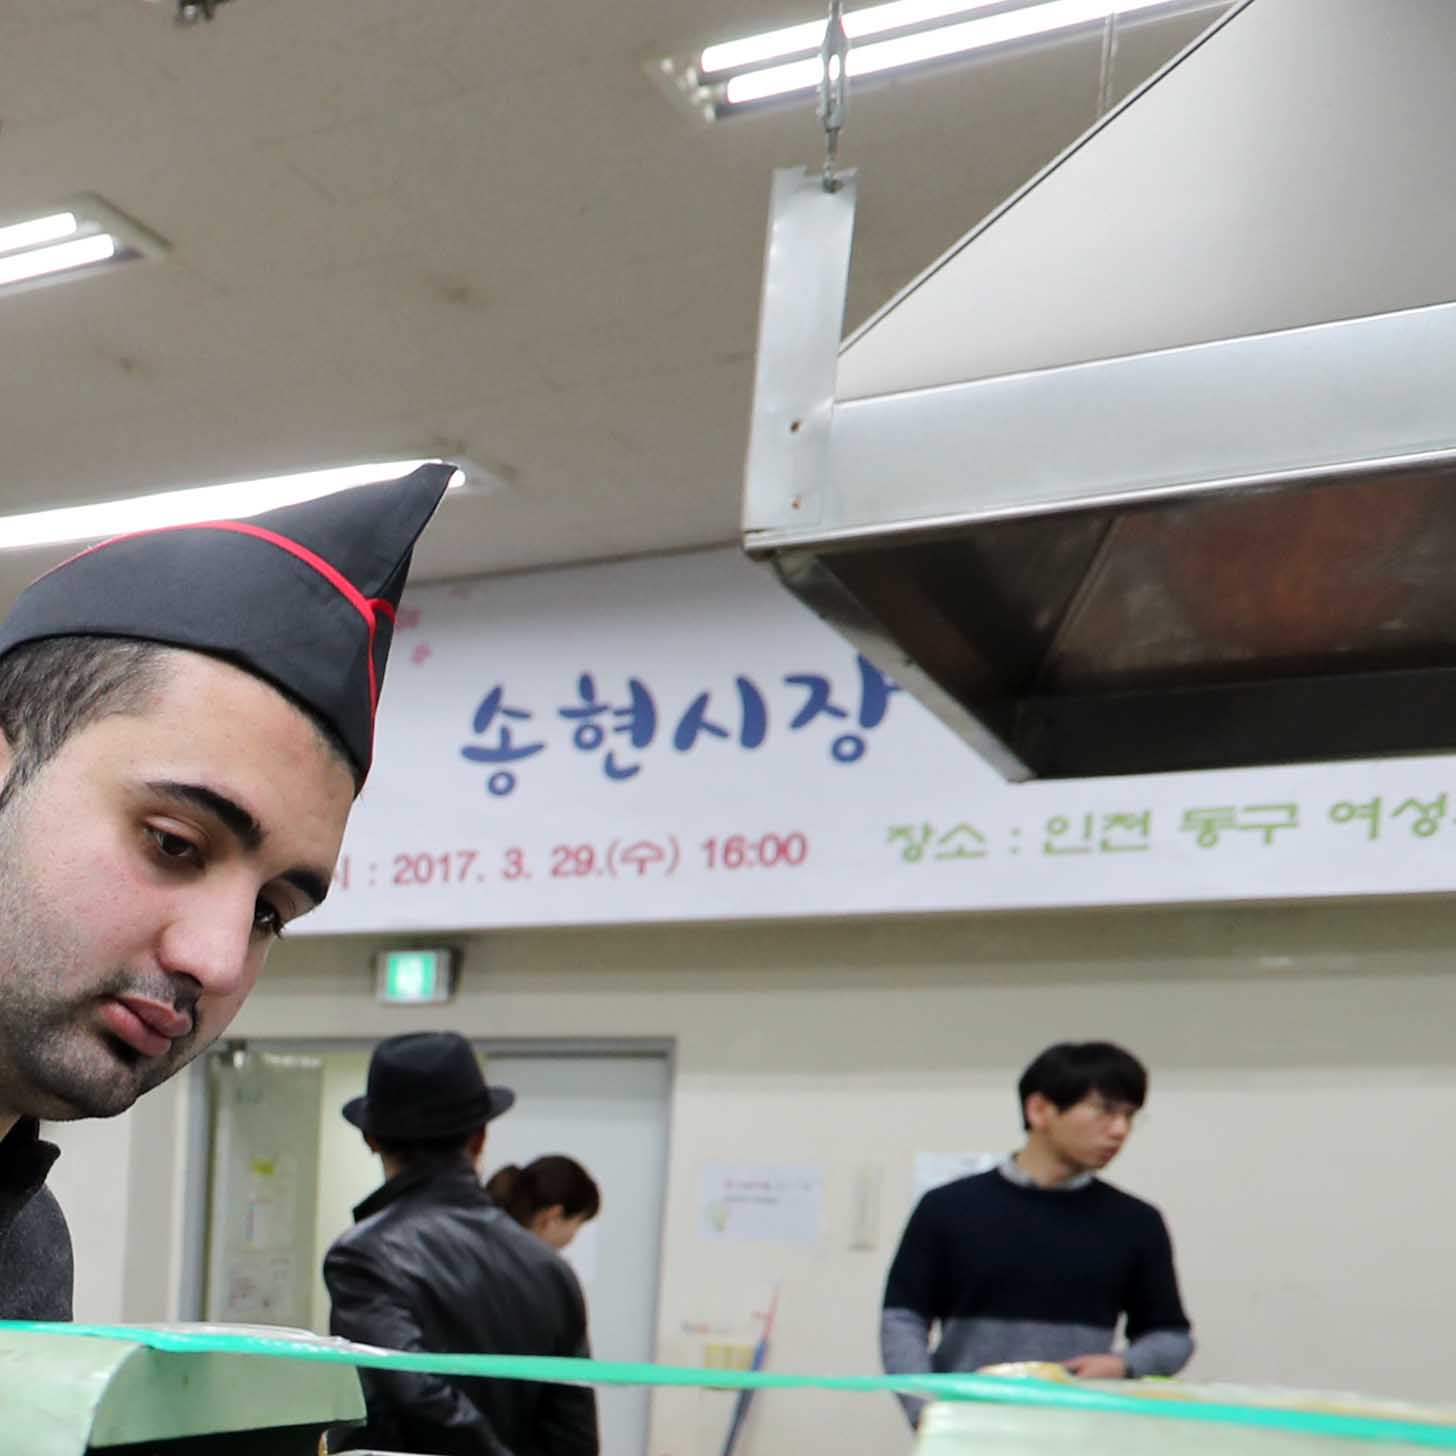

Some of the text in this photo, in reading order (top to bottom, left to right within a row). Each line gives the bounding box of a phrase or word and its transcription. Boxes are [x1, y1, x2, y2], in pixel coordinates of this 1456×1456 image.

[460, 653, 900, 797] 송현시장
[392, 849, 485, 886] 2017.
[502, 847, 532, 881] 3.
[702, 831, 809, 871] 16:00
[886, 821, 988, 864] 장소
[1043, 809, 1151, 856] 인천
[1180, 802, 1300, 849] 동구
[1328, 792, 1456, 841] 여성
